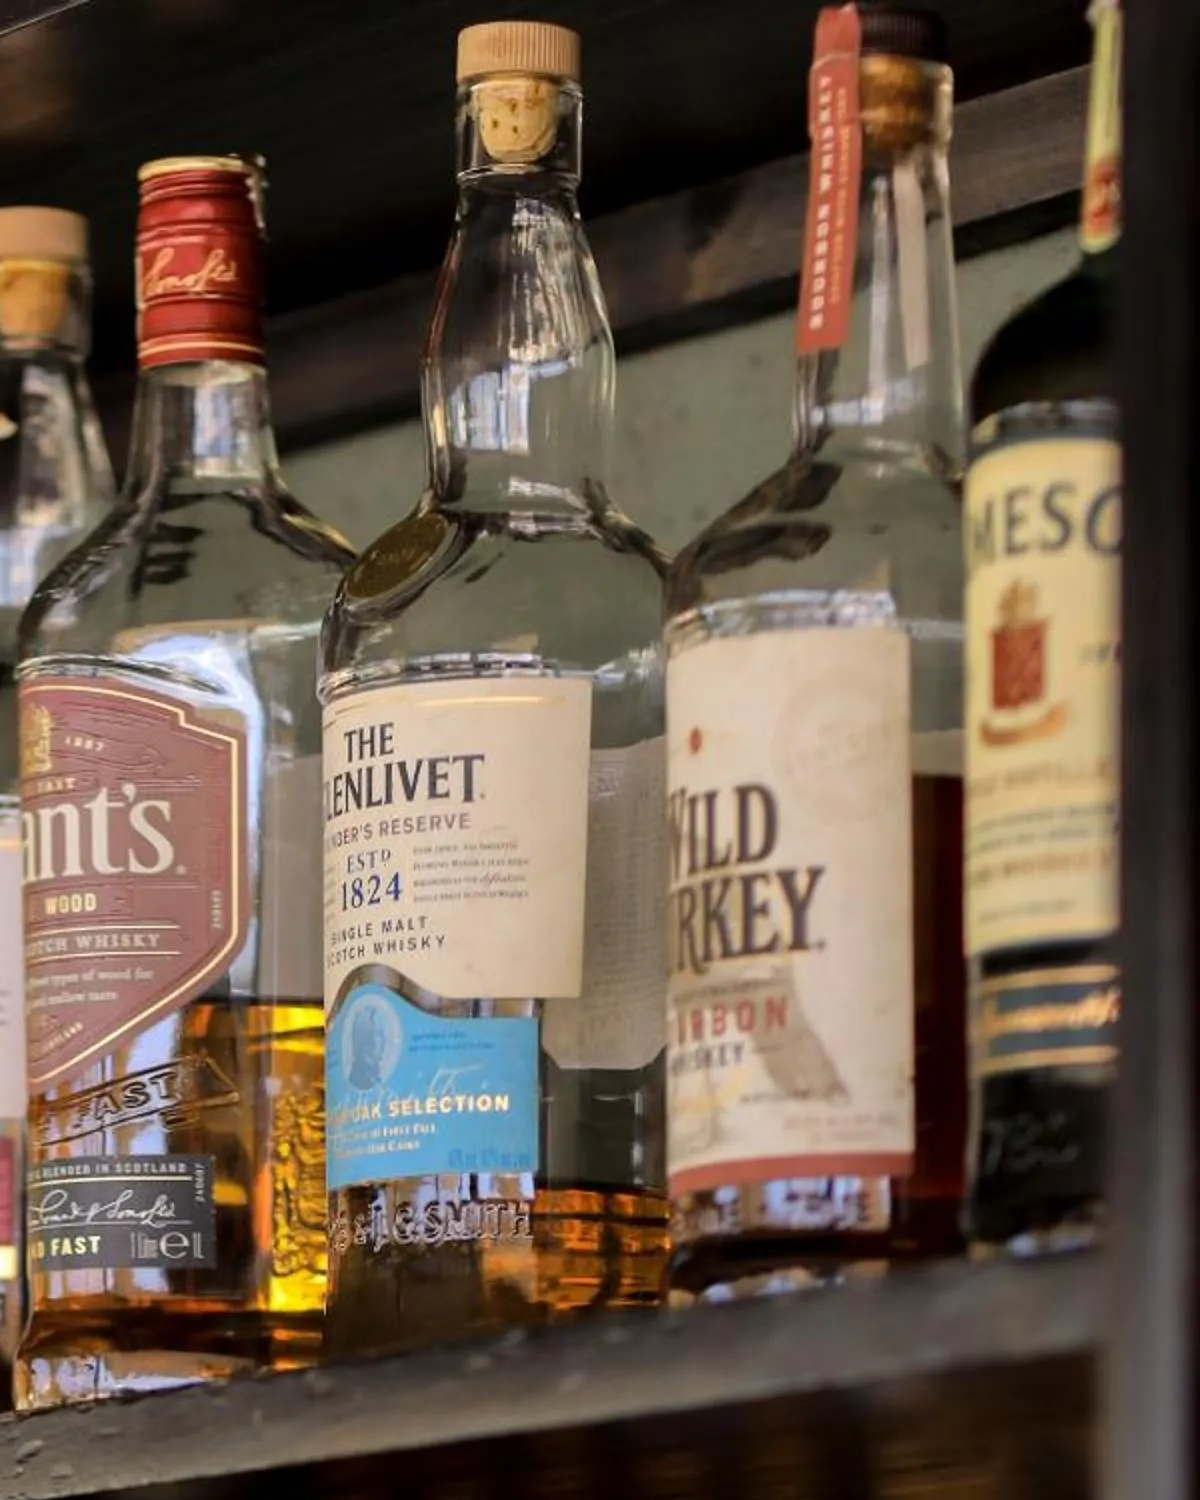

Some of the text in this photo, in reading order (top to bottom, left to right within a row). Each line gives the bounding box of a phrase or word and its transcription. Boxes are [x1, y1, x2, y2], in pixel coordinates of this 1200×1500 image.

[343, 722, 395, 764] THE
[378, 812, 472, 838] RESERVE
[341, 871, 403, 912] 1824
[44, 892, 98, 916] WOOD
[381, 914, 429, 936] MALT
[668, 864, 826, 978] RKEY
[76, 933, 161, 950] WHISKY
[373, 934, 446, 957] WHISKY
[388, 1094, 511, 1118] SELECTION
[43, 1161, 188, 1178] BLENDED IN SCOTLAND
[50, 1235, 102, 1257] FAST
